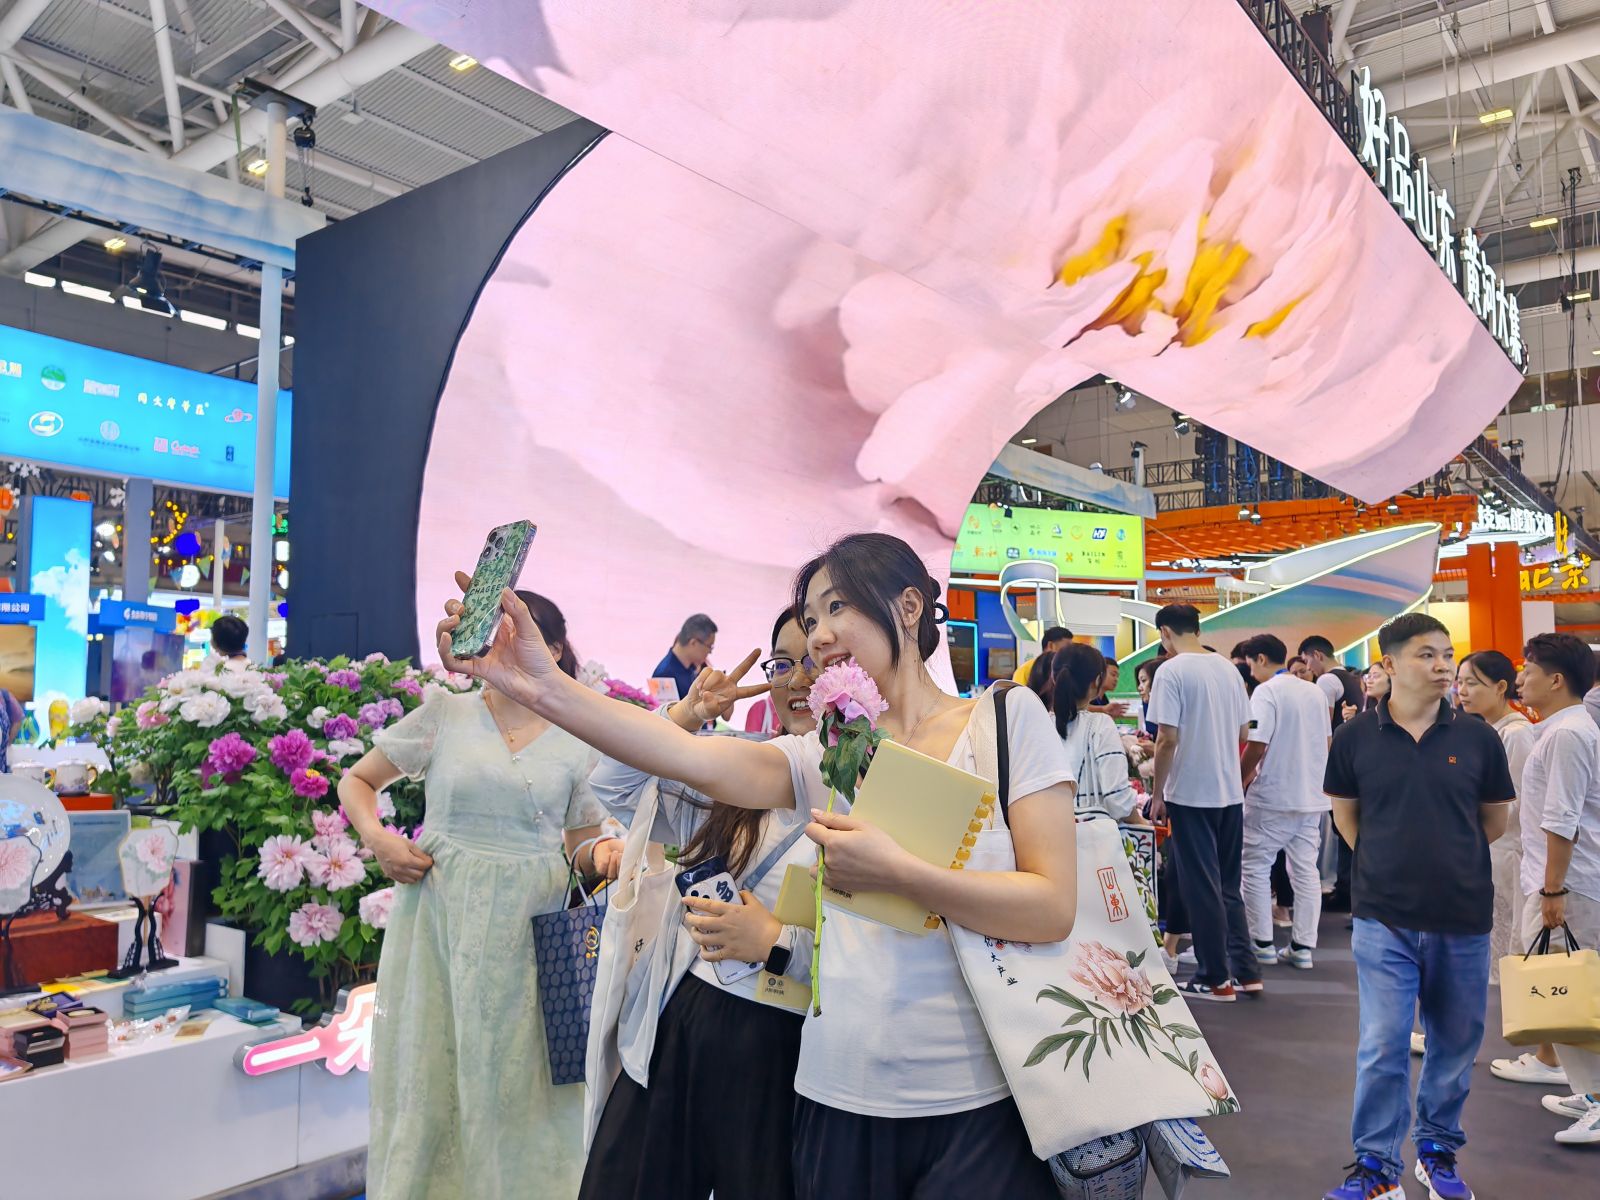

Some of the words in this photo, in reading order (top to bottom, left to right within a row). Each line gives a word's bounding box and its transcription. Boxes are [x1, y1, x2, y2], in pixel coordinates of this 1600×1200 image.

[1357, 66, 1458, 285] 好品山东
[1460, 227, 1523, 366] 黄河大集
[469, 583, 502, 596] CHAGEE
